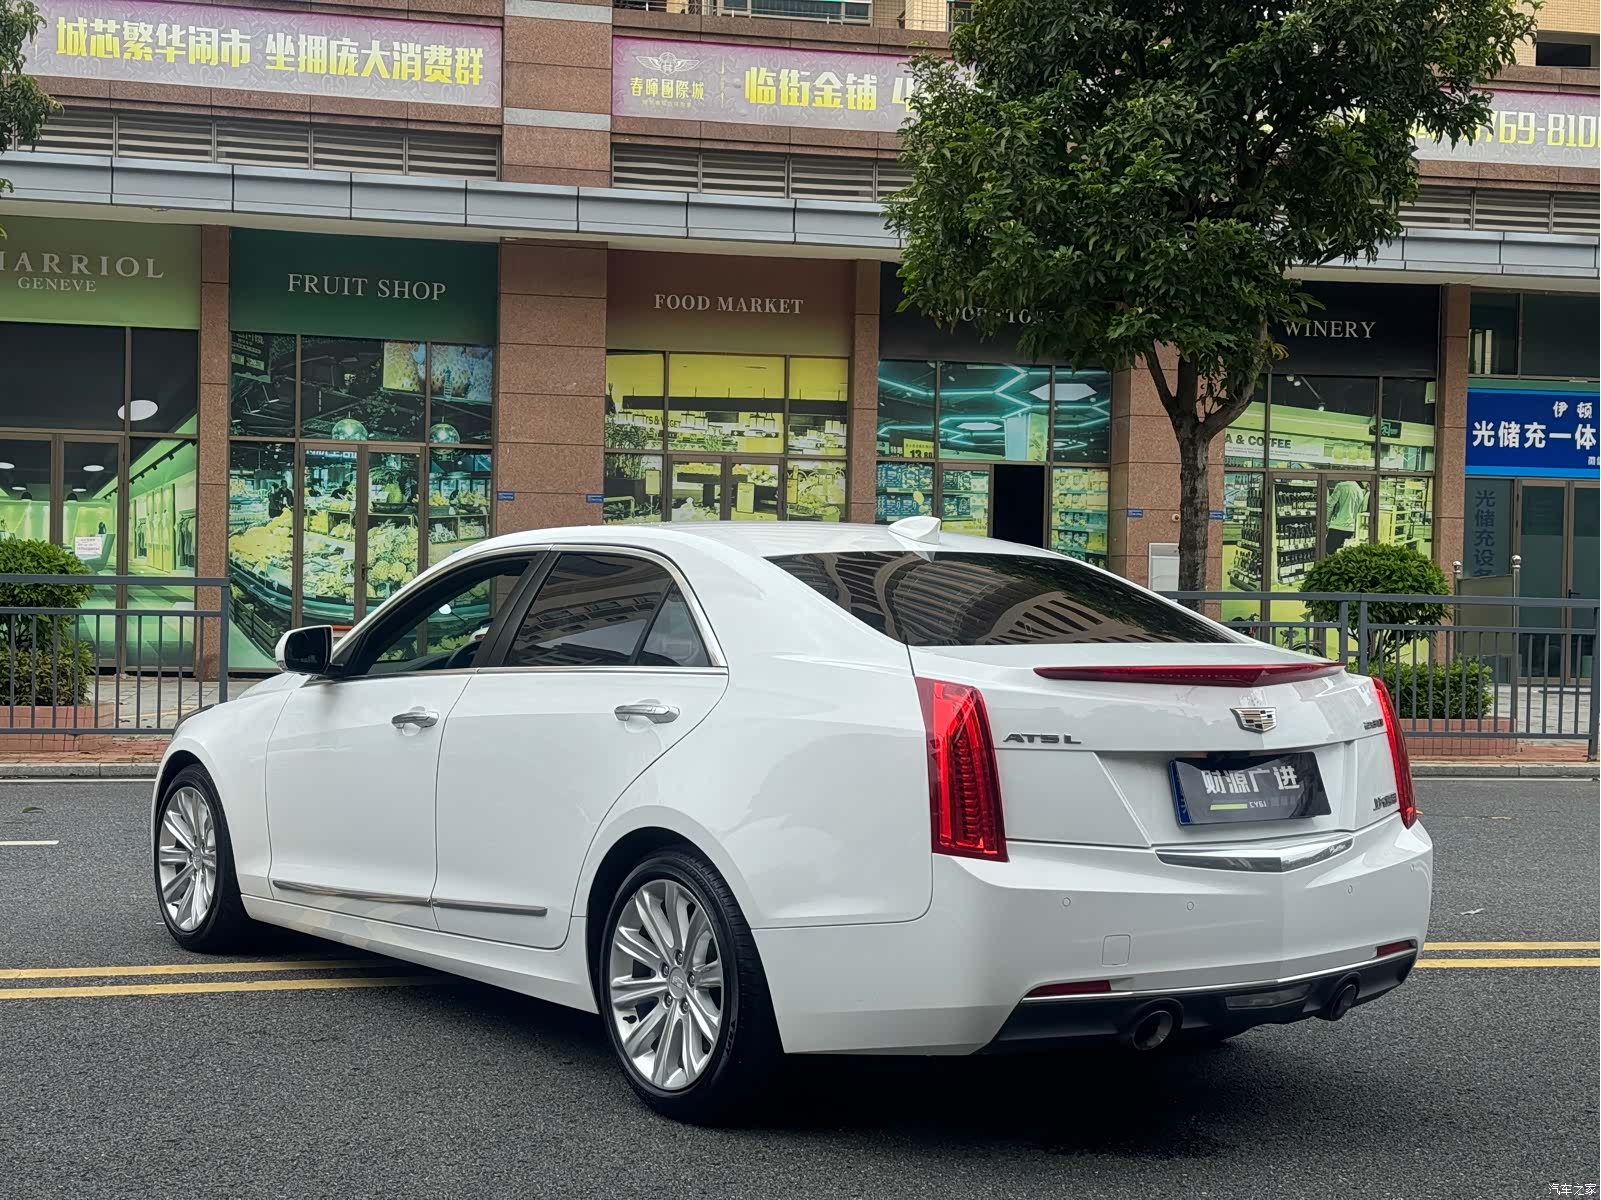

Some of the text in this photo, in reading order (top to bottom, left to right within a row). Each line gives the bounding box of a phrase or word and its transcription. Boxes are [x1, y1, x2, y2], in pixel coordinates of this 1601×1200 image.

[56, 16, 484, 86] 城芯繁华闹市 坐拥庞大消费群
[744, 67, 877, 110] 临街金铺
[17, 276, 97, 292] GENEVE
[287, 273, 447, 301] FRUIT SHOP
[653, 294, 804, 314] FOOD MARKET
[1285, 320, 1376, 338] WINERY
[1553, 401, 1593, 419] 伊顿
[1248, 436, 1292, 449] COFEE
[1472, 420, 1596, 450] 光储充一体
[1201, 765, 1300, 795] 财源广进
